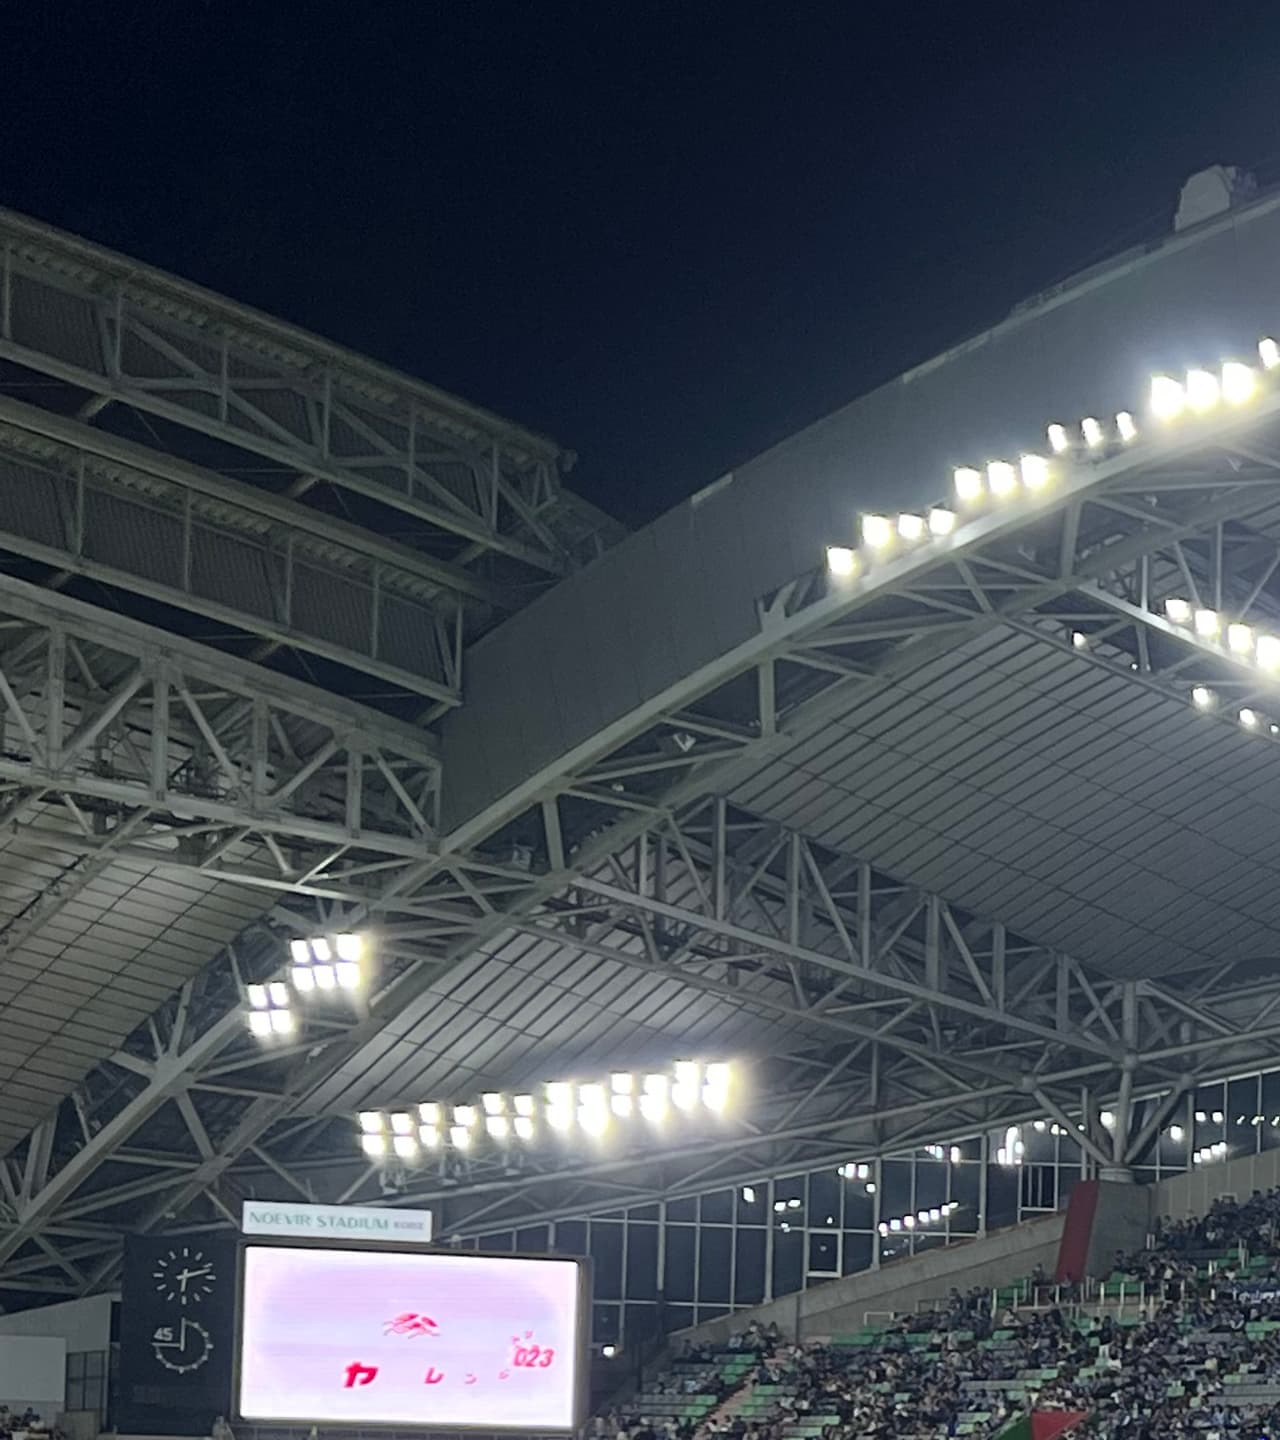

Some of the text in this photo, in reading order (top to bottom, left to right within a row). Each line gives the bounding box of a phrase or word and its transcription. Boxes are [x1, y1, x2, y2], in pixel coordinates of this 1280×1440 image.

[250, 1211, 311, 1227] NOEVIR
[317, 1216, 389, 1231] STADIUM
[153, 1327, 173, 1341] 45
